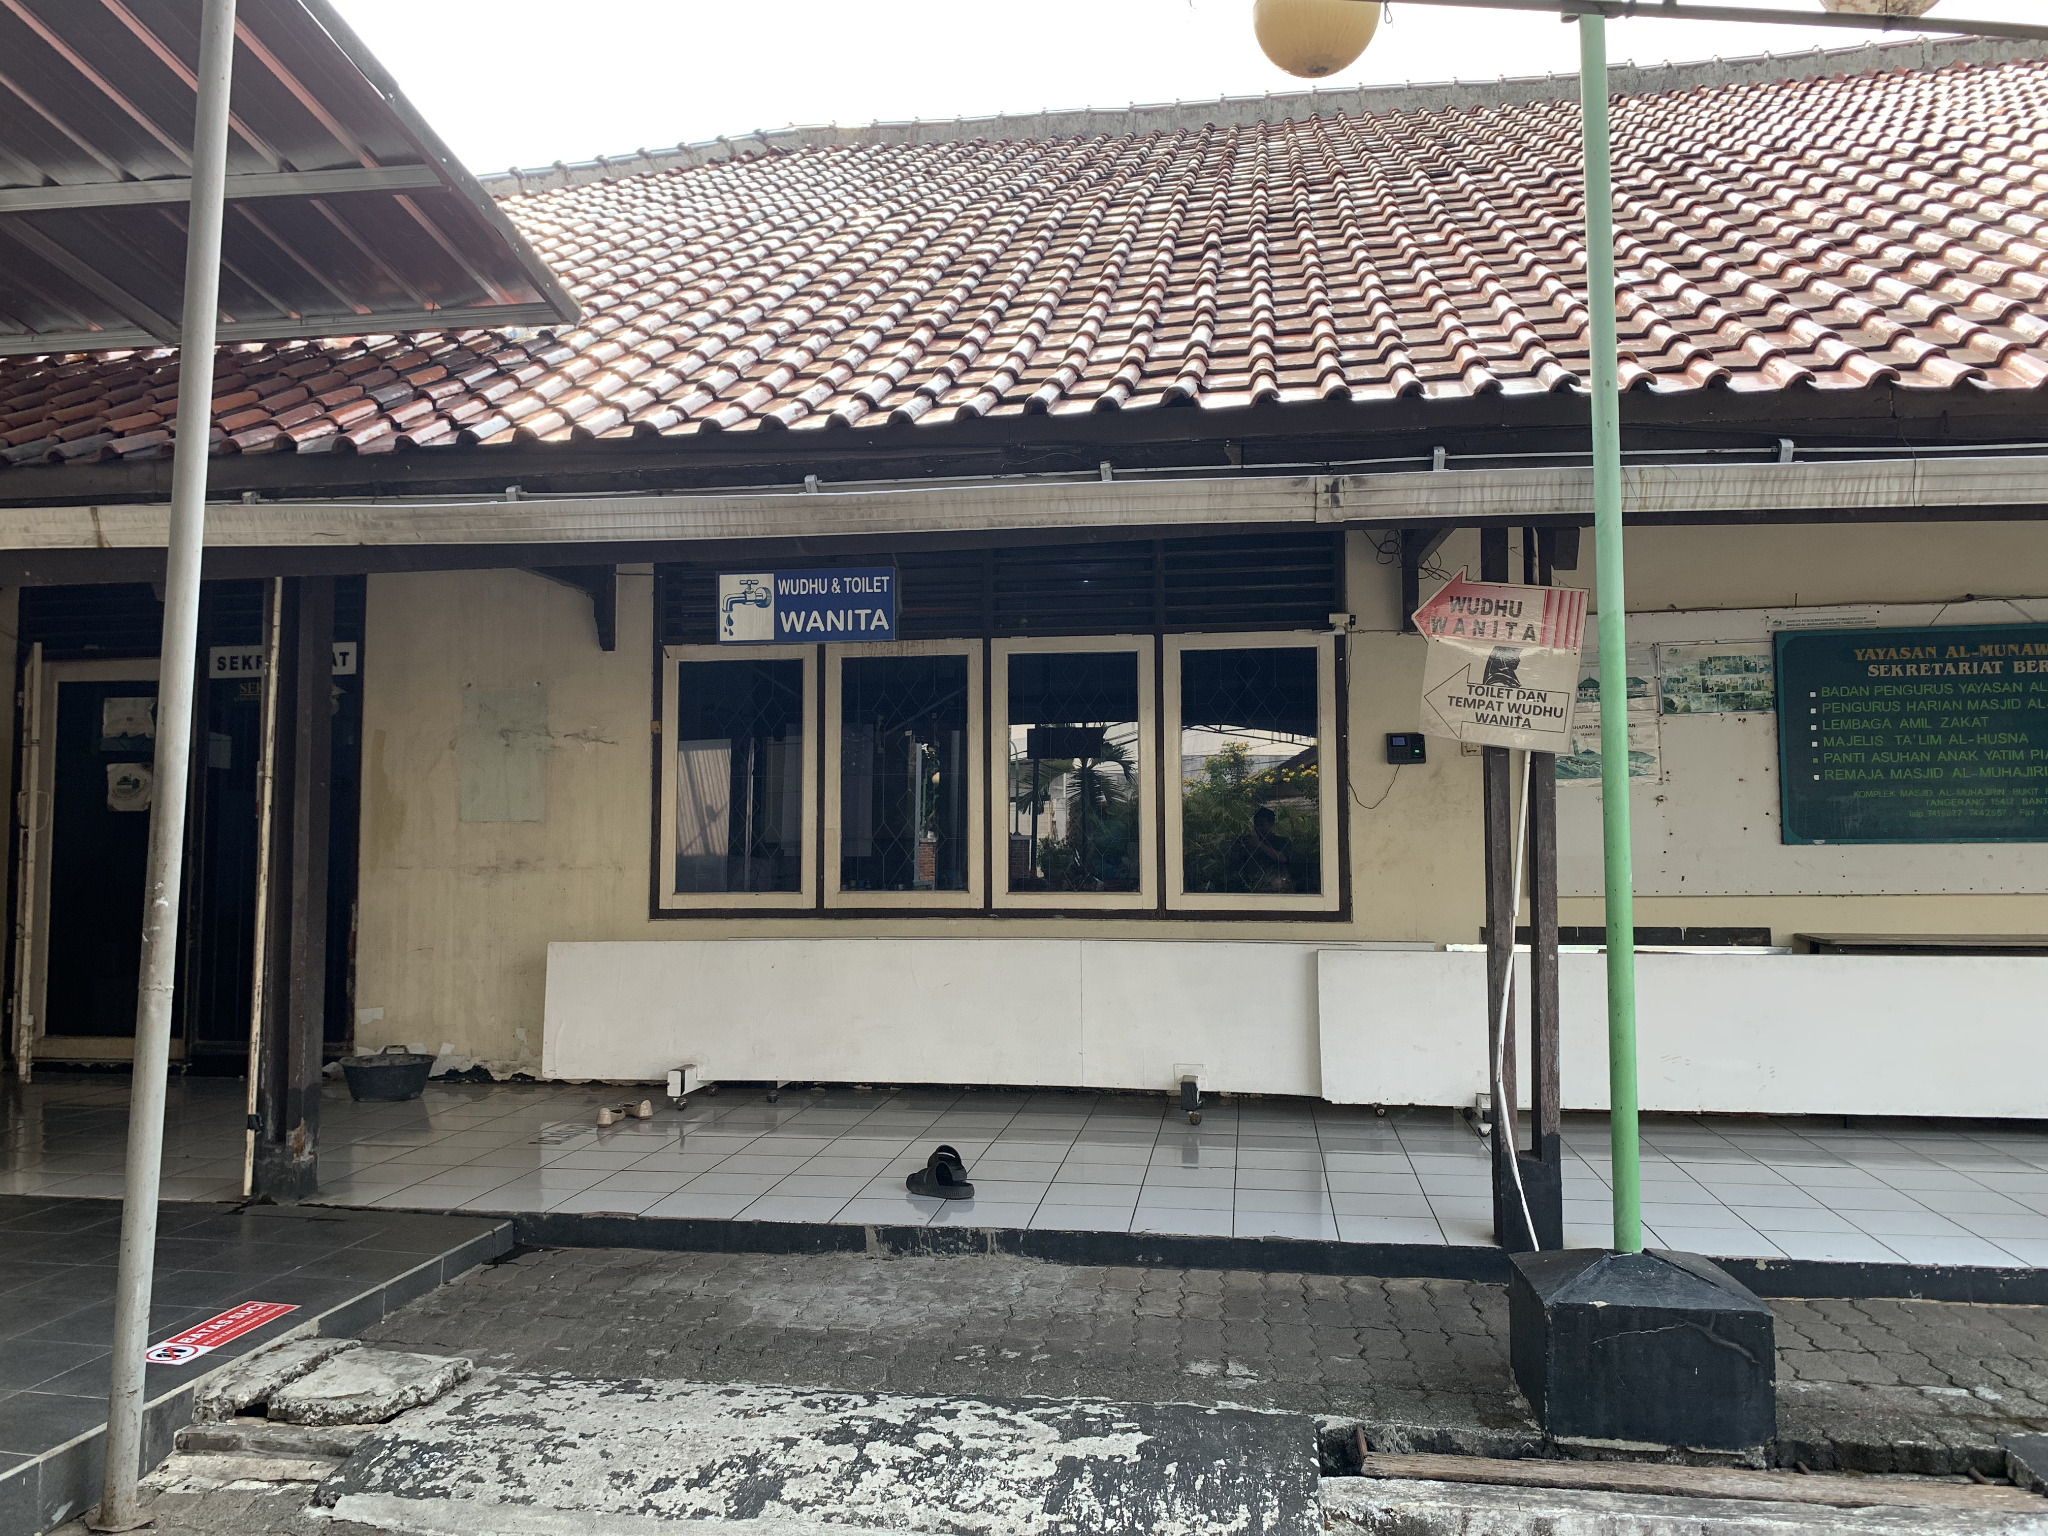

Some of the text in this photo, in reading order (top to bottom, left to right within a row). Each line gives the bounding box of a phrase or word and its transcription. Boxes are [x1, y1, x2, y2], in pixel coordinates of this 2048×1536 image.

[777, 576, 890, 595] WUDHU & TOILET
[1449, 595, 1523, 618] WUDHU
[780, 608, 890, 633] WANITA
[1430, 615, 1537, 642] WANITA
[1853, 646, 1937, 661] YAYASAN
[1867, 660, 2004, 677] SEKRETARIAT
[1467, 684, 1547, 704] TOILET DAN
[1822, 686, 1870, 698] BADAN
[1874, 683, 1954, 697] PENGURUS
[1959, 681, 2023, 695] YAYASAN
[1448, 695, 1564, 719] TEMPAT WUDHU
[1822, 700, 1901, 714] PENGURUS
[1906, 699, 1962, 712] HARIAN
[1967, 698, 2021, 711] MASJID
[1475, 711, 1532, 729] WANITA
[1823, 716, 1990, 731] LEMBAGA AMIL ZAKAT
[1823, 732, 2029, 747] MAJELIS TA'LIM AL-HUSNA
[1824, 752, 1865, 764] PANTI
[1871, 751, 1931, 763] ASUHAN
[1937, 750, 1979, 762] ANAK
[1983, 749, 2024, 761] YATIM
[1825, 769, 1885, 781] REMAJA
[1890, 768, 1944, 780] MASJID
[1853, 790, 1895, 798] KOMPLEK
[1926, 798, 1986, 807] TANGERANG
[177, 1303, 269, 1344] BATAS SUCI
